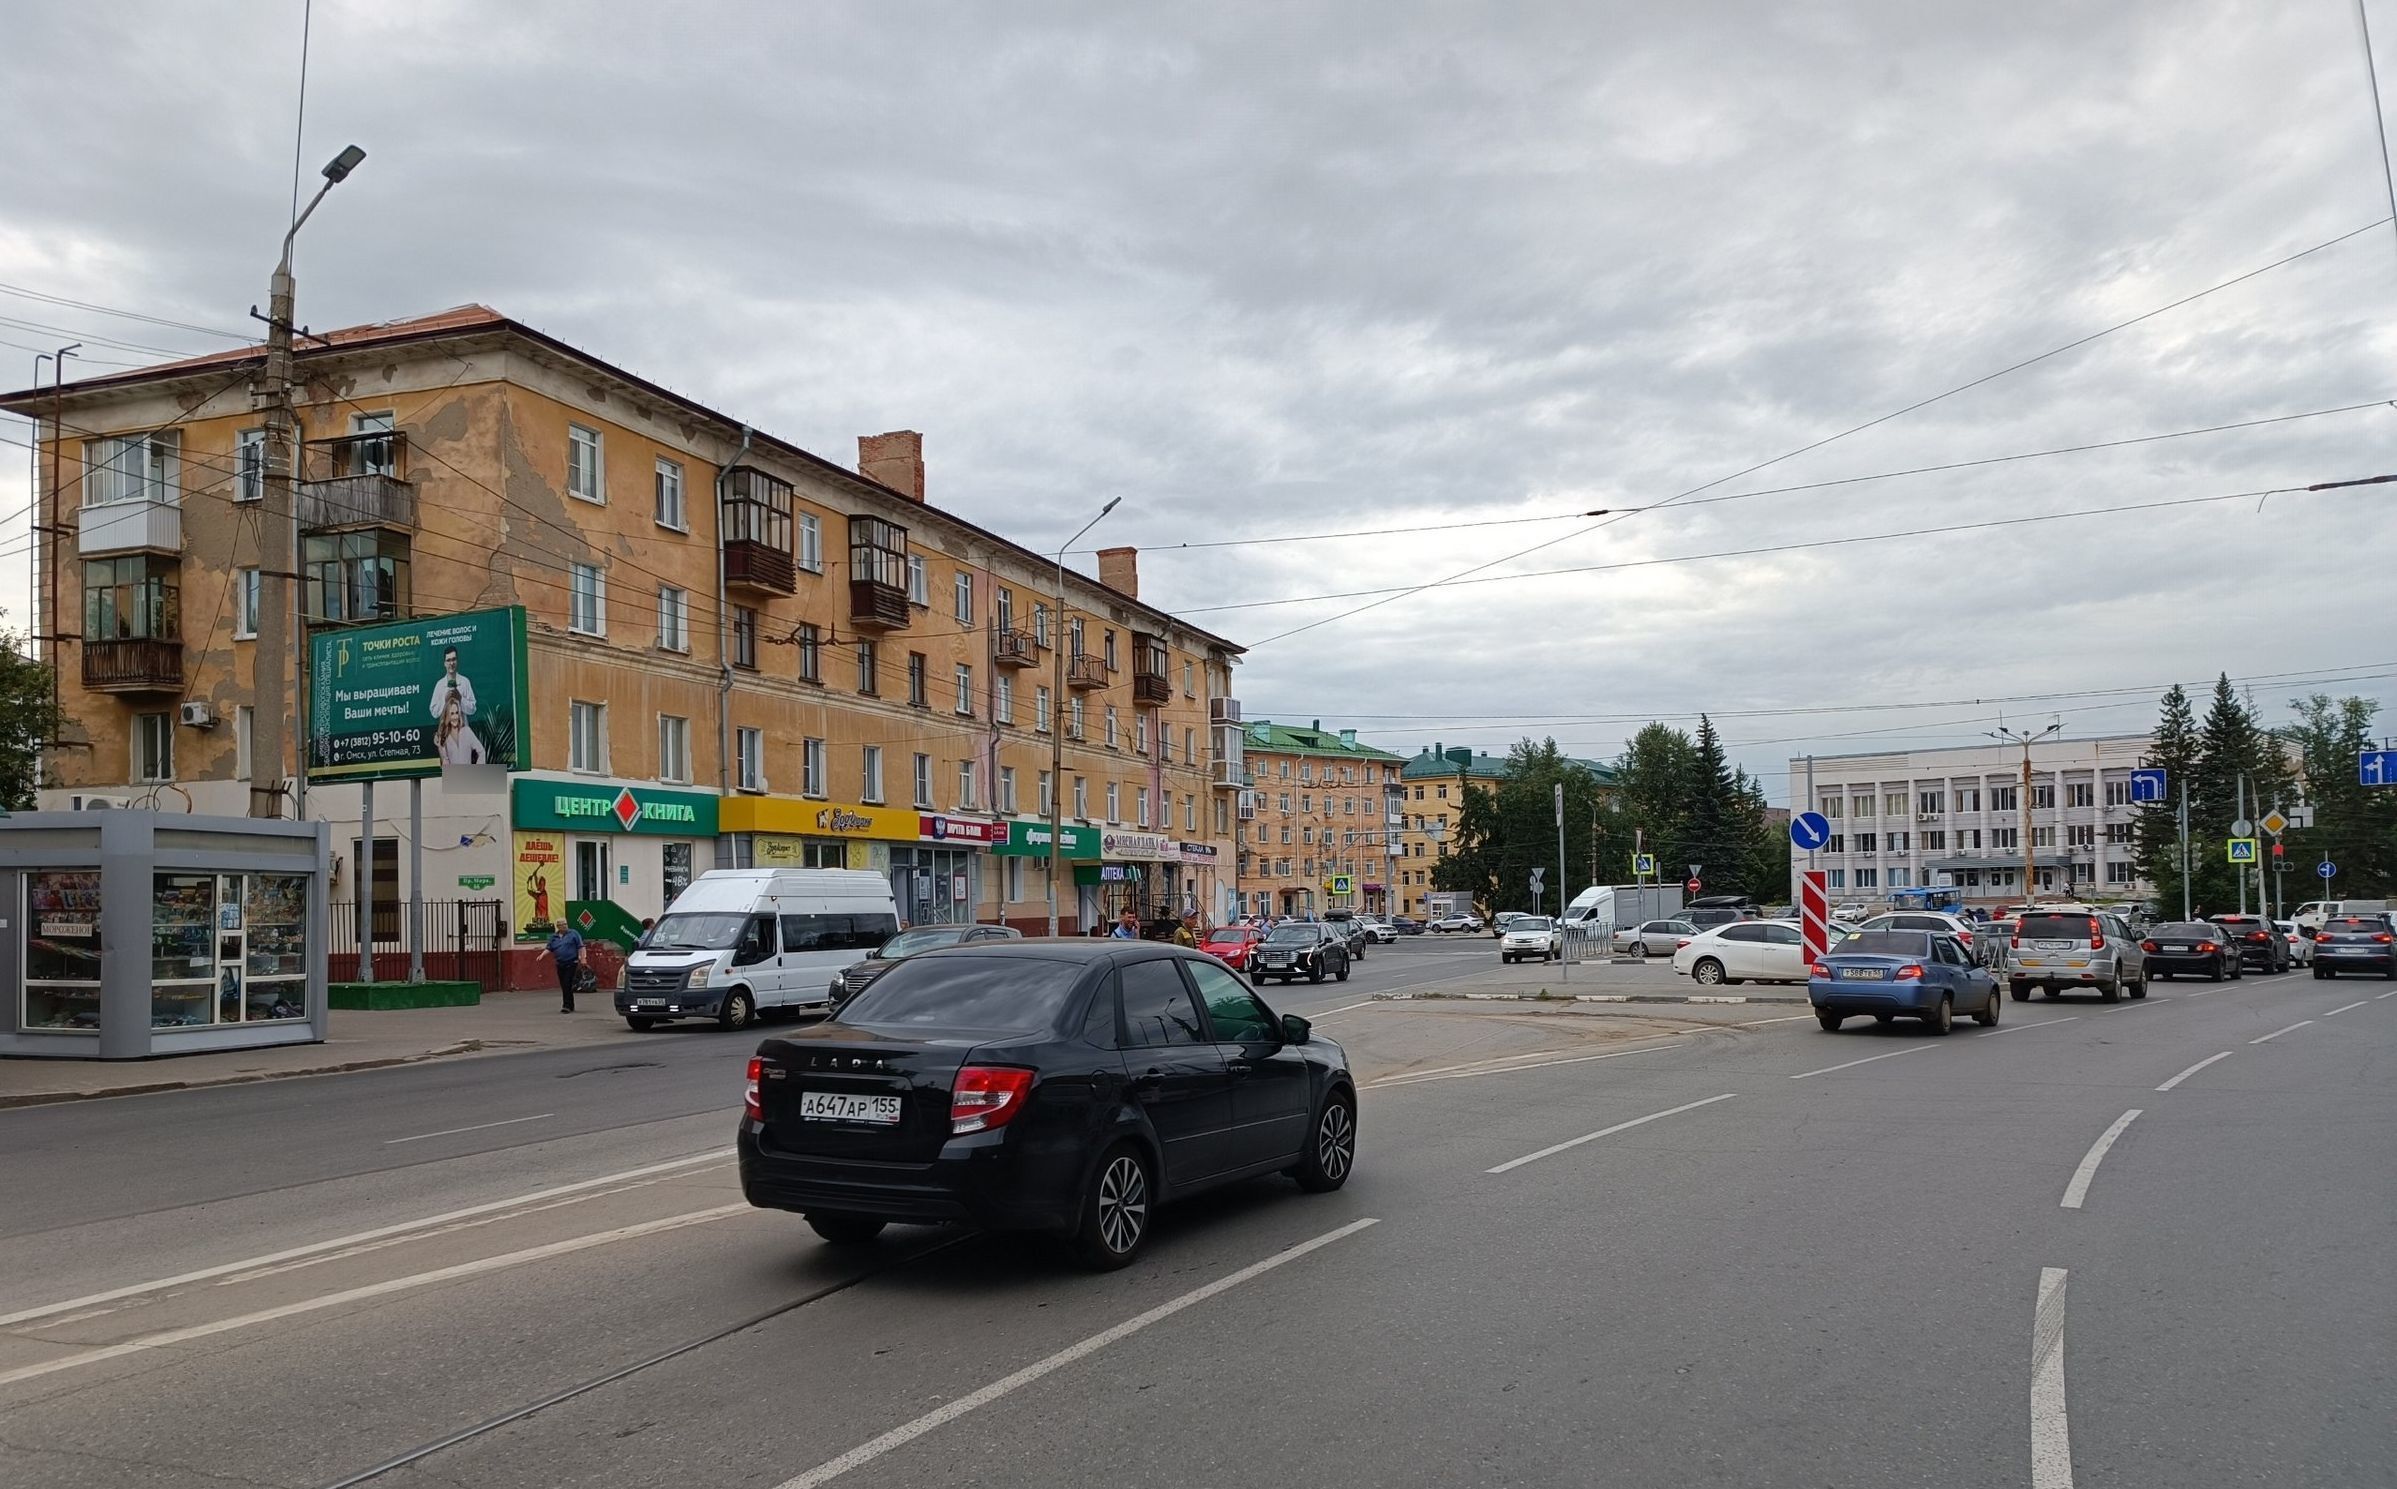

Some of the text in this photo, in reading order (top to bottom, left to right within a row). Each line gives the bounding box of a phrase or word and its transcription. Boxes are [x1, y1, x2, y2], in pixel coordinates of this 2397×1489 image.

[426, 629, 451, 638] ЛЕЧЕНИЕ
[452, 626, 471, 635] ВОЛОС
[431, 634, 472, 645] КОЖИ ГОЛОВЫ
[363, 636, 420, 651] ТОЧКИ РОСТА
[335, 684, 420, 702] Мы выращиваем
[345, 701, 409, 719] Ваши мечты!
[351, 736, 371, 748] (3812)
[372, 729, 420, 745] 95-10-60
[346, 751, 367, 760] Омск,
[379, 747, 410, 760] Степная,
[412, 745, 421, 754] 73
[555, 795, 695, 822] ЦЕНТР КНИГА
[525, 838, 553, 851] ДАЁШЬ
[1101, 866, 1124, 880] АПТЕКА
[810, 1056, 884, 1069] LADA
[806, 1096, 897, 1117] А647АР 155
